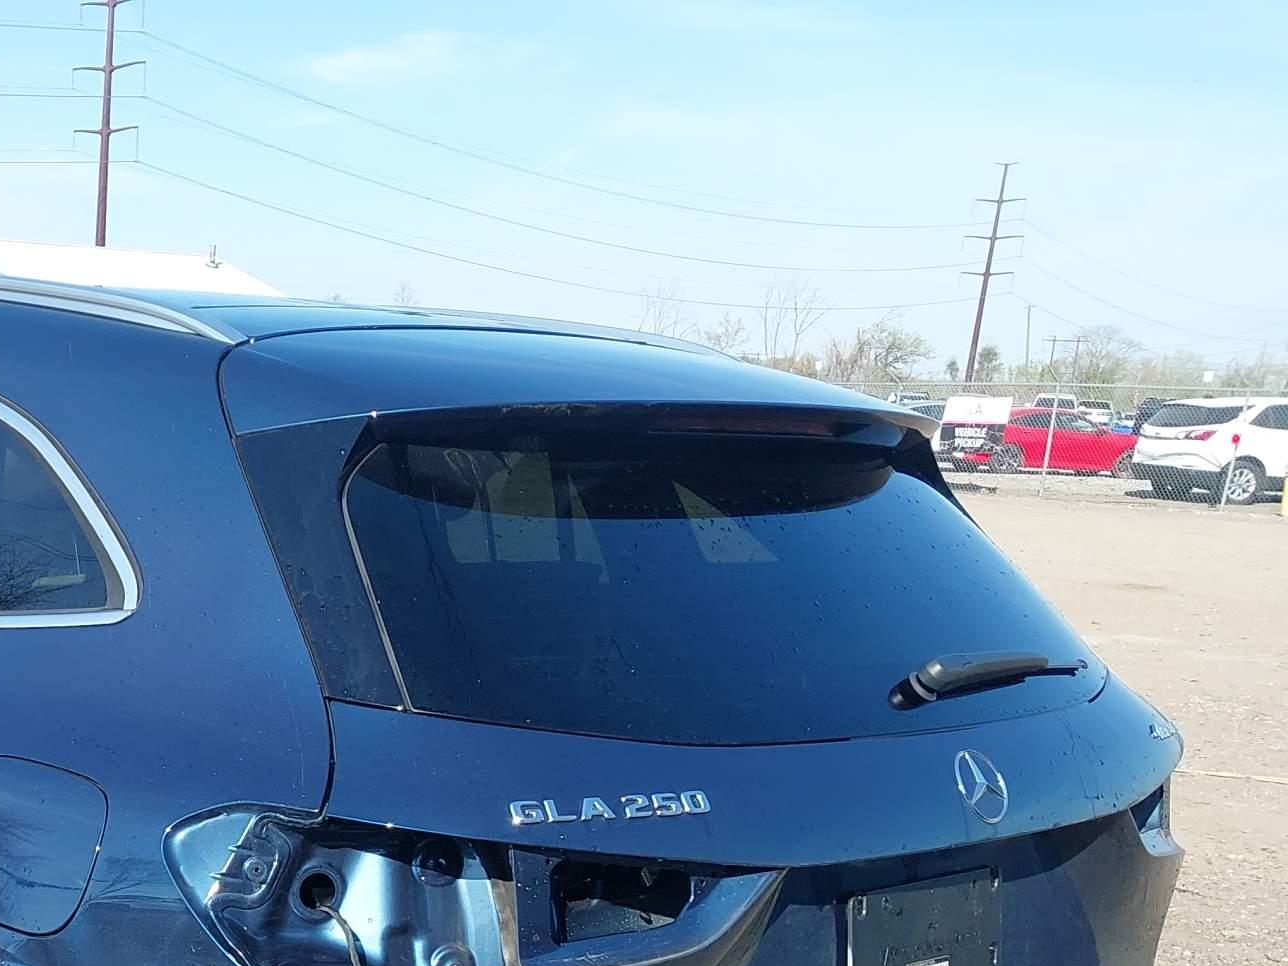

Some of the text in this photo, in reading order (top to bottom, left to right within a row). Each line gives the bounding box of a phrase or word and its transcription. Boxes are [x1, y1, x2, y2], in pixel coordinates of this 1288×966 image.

[955, 427, 987, 438] VEHICLE
[955, 438, 984, 448] PICKUP
[509, 789, 711, 825] GLA 250
